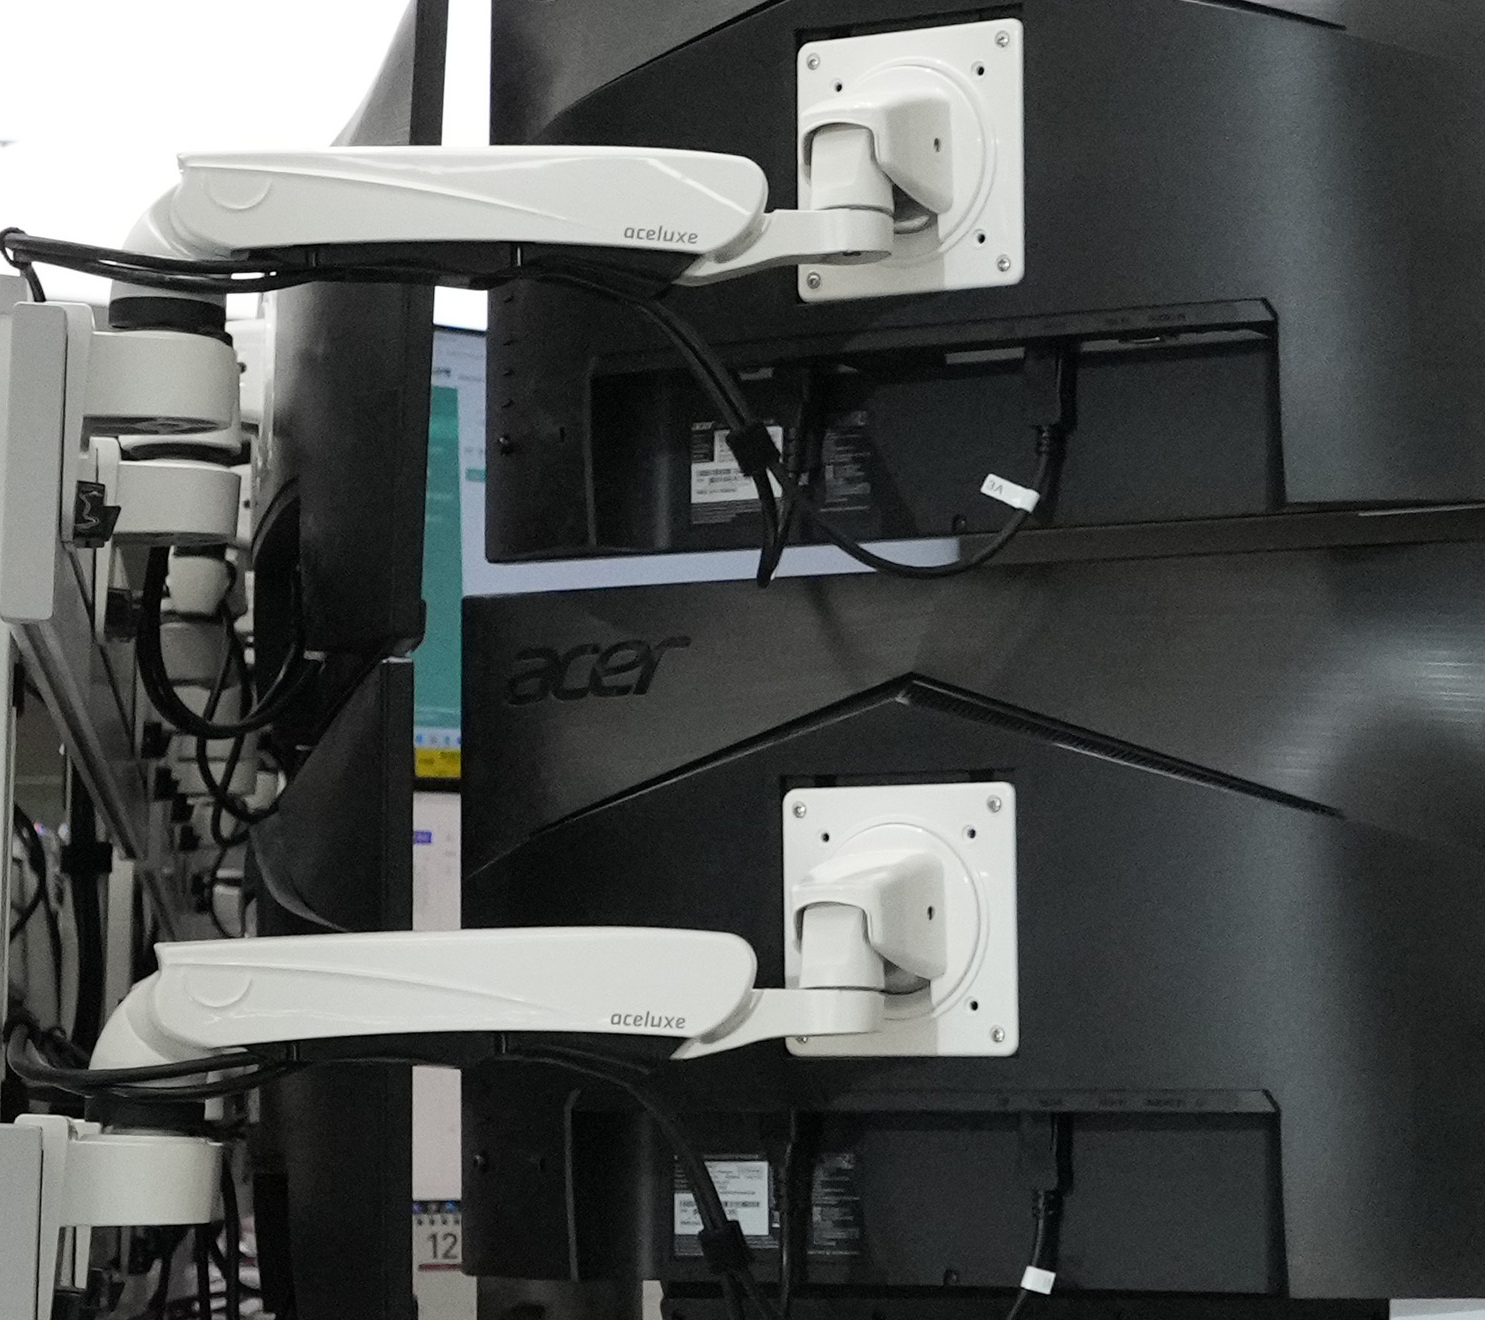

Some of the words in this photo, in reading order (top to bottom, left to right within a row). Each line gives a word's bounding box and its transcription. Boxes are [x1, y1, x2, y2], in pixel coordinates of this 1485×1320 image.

[624, 224, 698, 246] aceluxe
[505, 635, 692, 708] acer
[610, 1010, 686, 1030] aceluxe
[427, 1232, 459, 1259] 12
